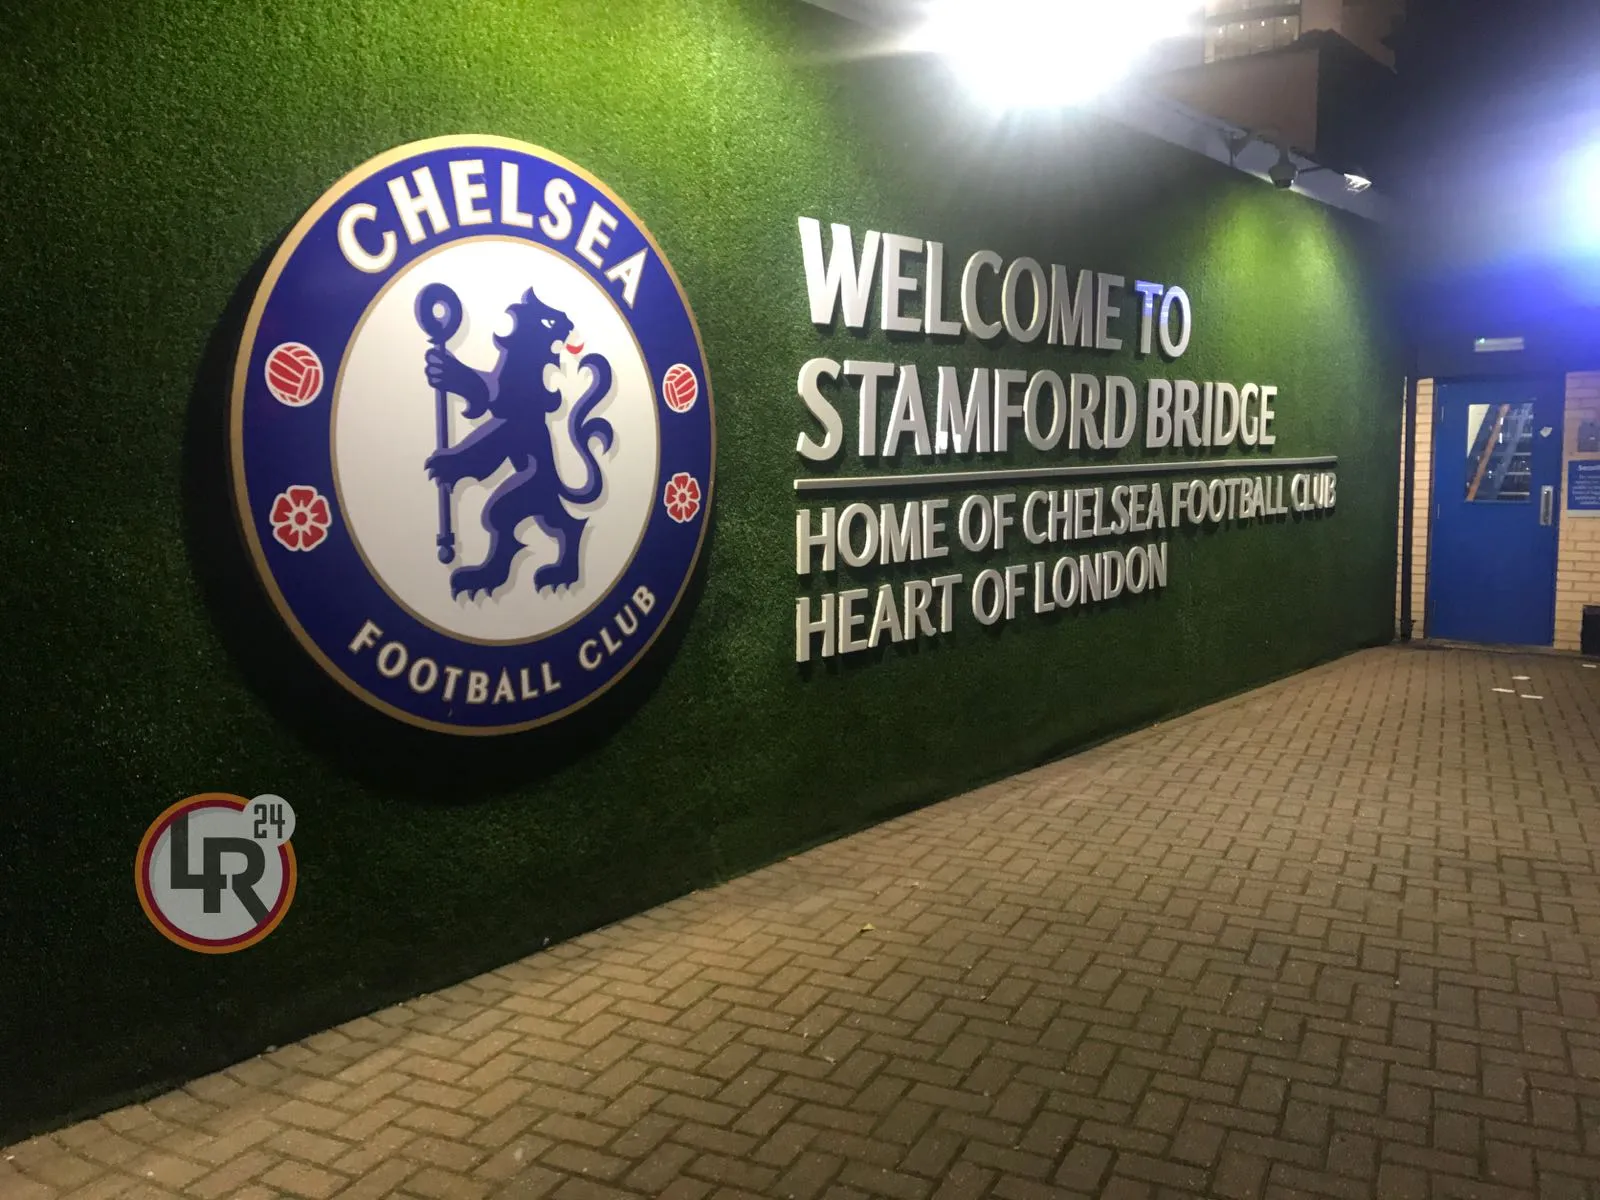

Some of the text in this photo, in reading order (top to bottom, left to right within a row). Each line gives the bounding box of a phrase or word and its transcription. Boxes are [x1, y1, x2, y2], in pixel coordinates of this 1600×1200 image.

[337, 158, 649, 310] CHELSEA
[797, 216, 1192, 359] WELCOME TO
[796, 357, 1279, 462] STAMFORD BRIDGE
[795, 472, 1338, 575] HOME OF CHELSEA FOOTBALL CLUB
[347, 584, 657, 706] FOOTBALL CLUB
[795, 542, 1169, 663] HEART OF LONDON
